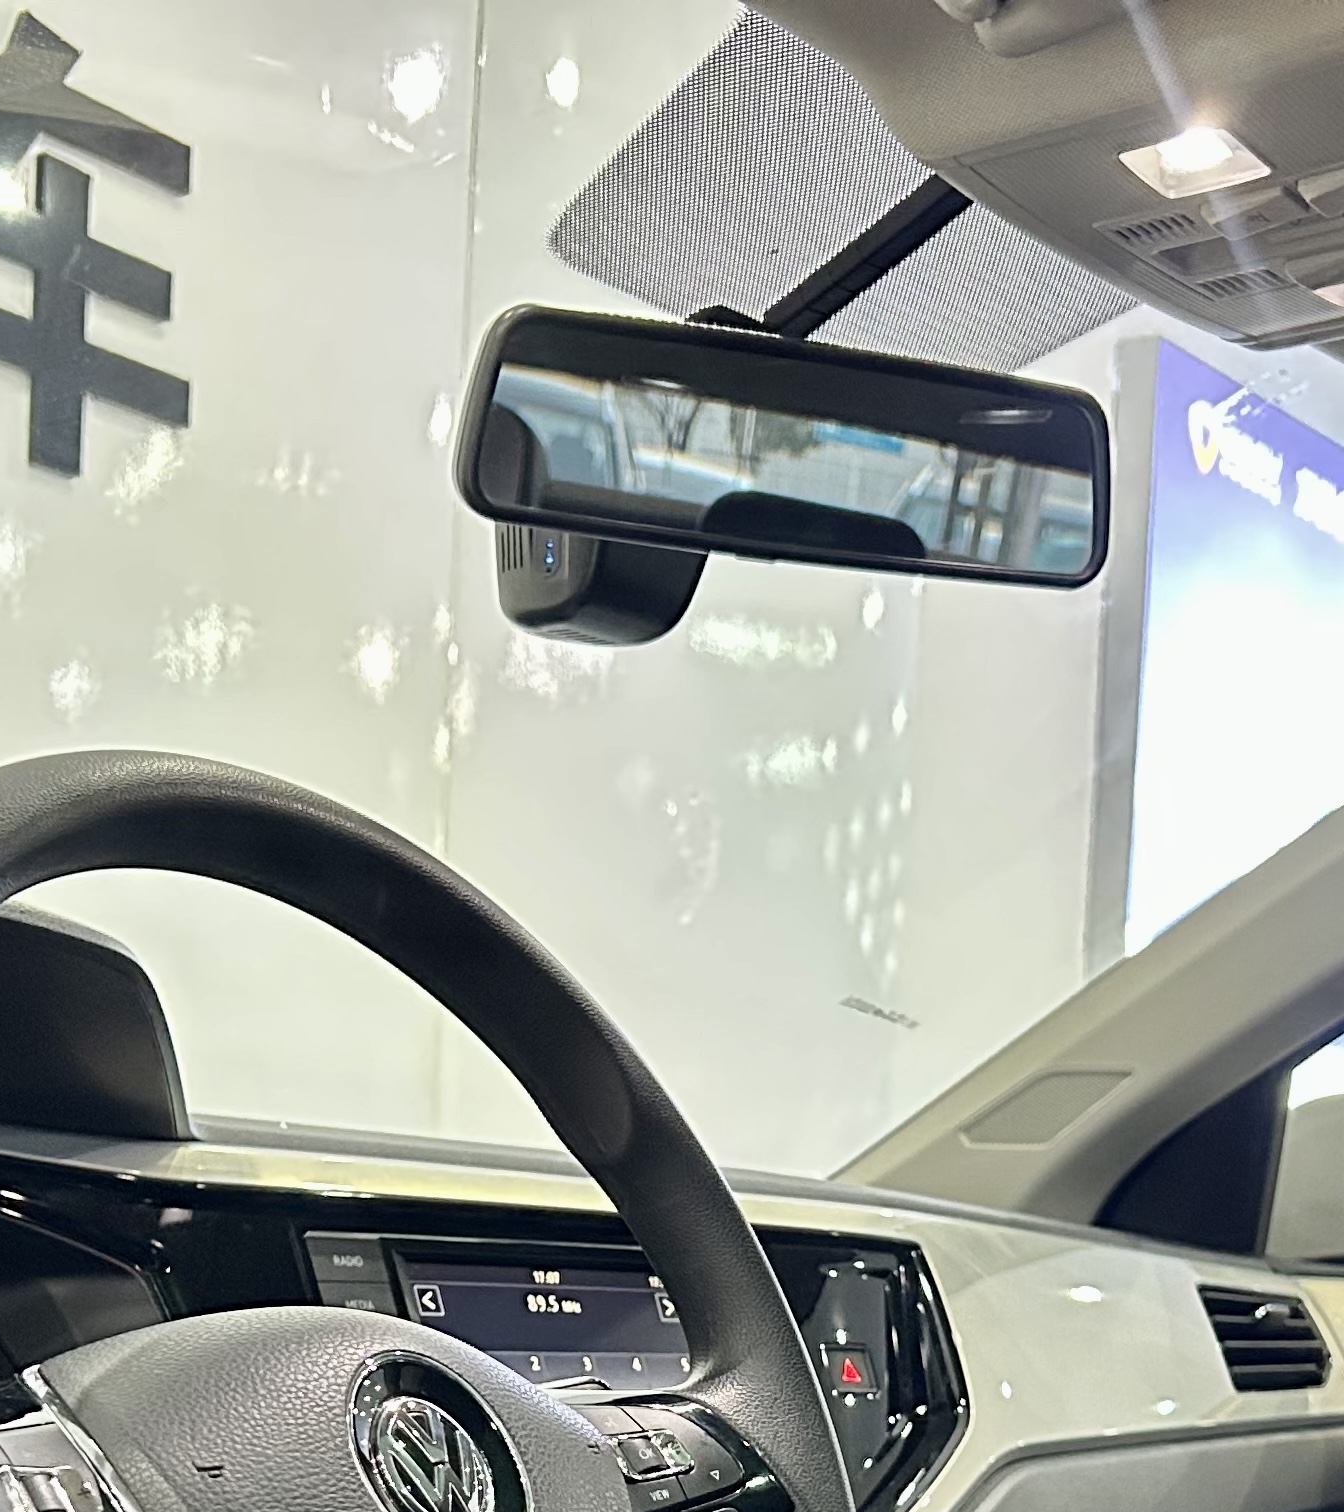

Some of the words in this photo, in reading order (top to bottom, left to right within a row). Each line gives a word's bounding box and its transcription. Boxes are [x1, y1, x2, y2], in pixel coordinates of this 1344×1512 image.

[332, 1254, 364, 1268] RADIO
[526, 1293, 560, 1313] 89.5
[529, 1355, 542, 1372] 2
[582, 1355, 593, 1372] 3
[632, 1356, 642, 1372] 4
[680, 1356, 691, 1373] 5
[638, 1446, 656, 1460] OK
[648, 1488, 670, 1502] VIEW
